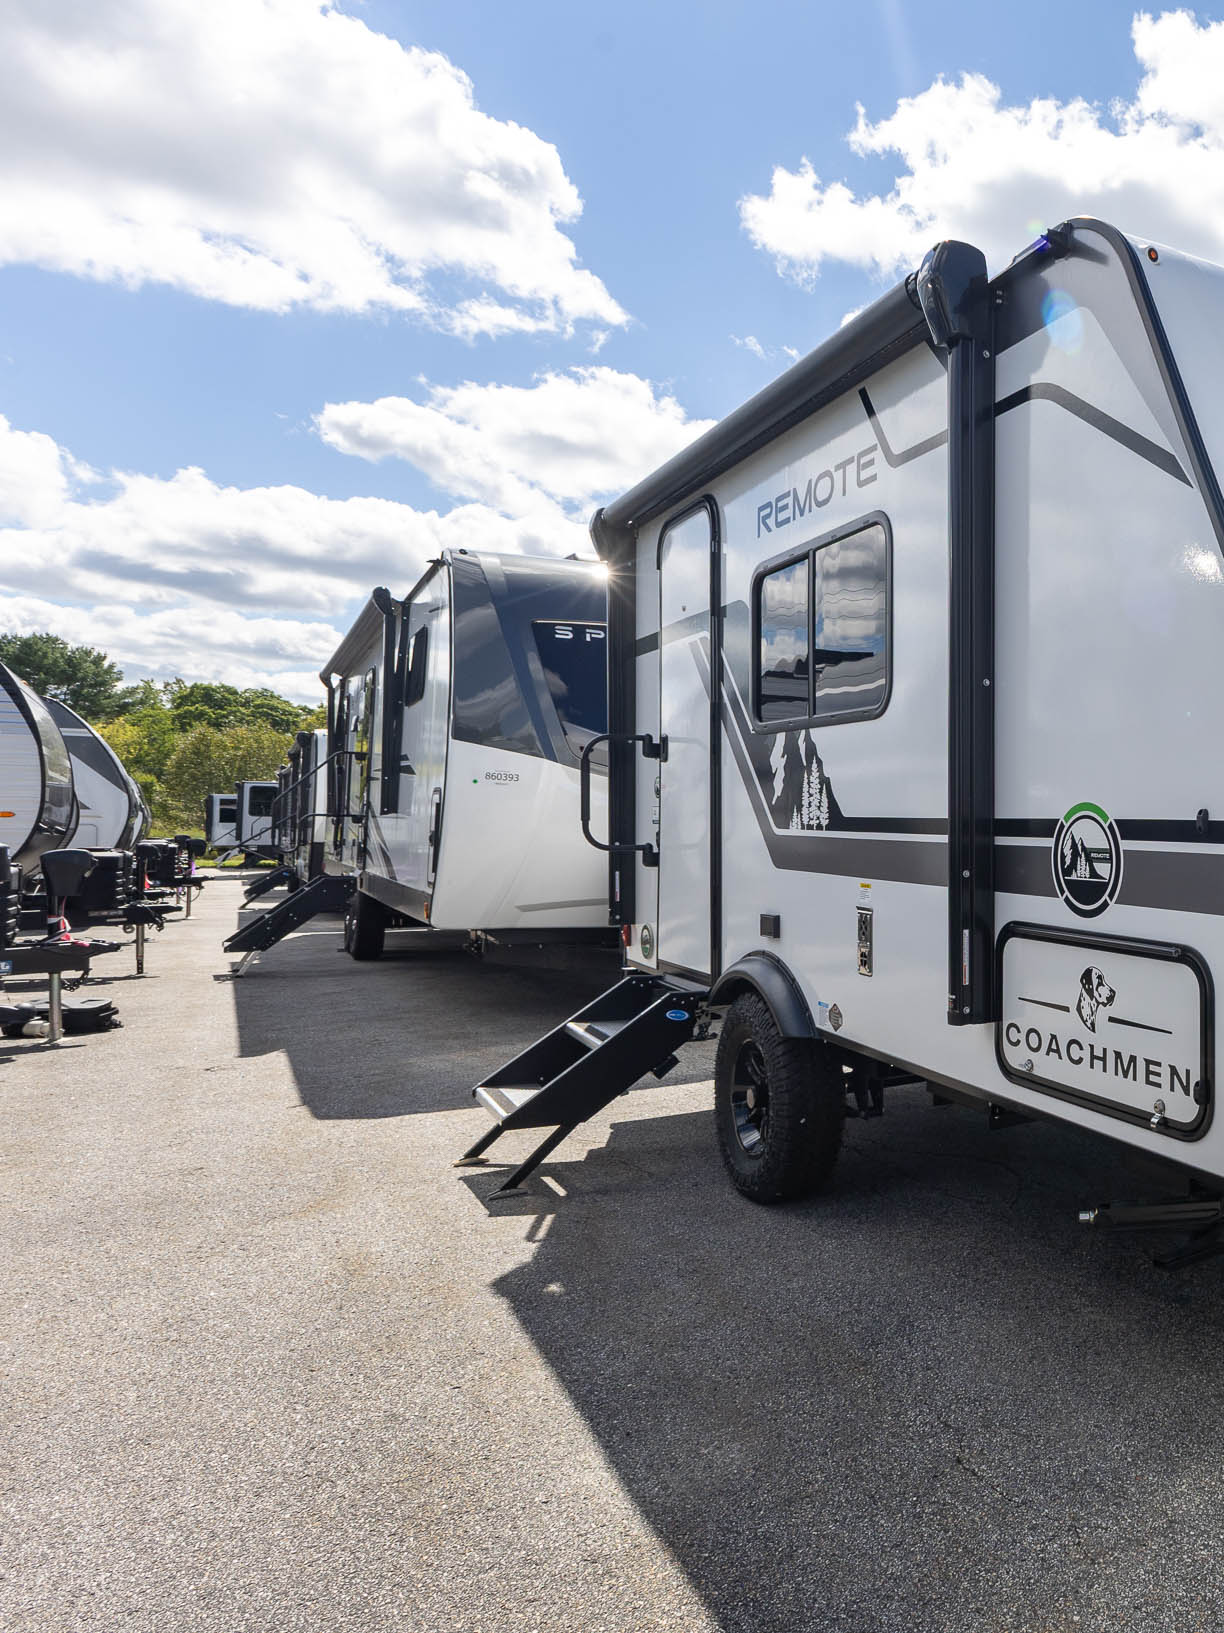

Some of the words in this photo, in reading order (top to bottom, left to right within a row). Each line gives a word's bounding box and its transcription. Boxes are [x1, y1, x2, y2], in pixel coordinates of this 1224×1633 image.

[757, 443, 878, 538] REMOTE
[485, 772, 520, 782] 860393
[1005, 1022, 1191, 1097] COACHMEN
